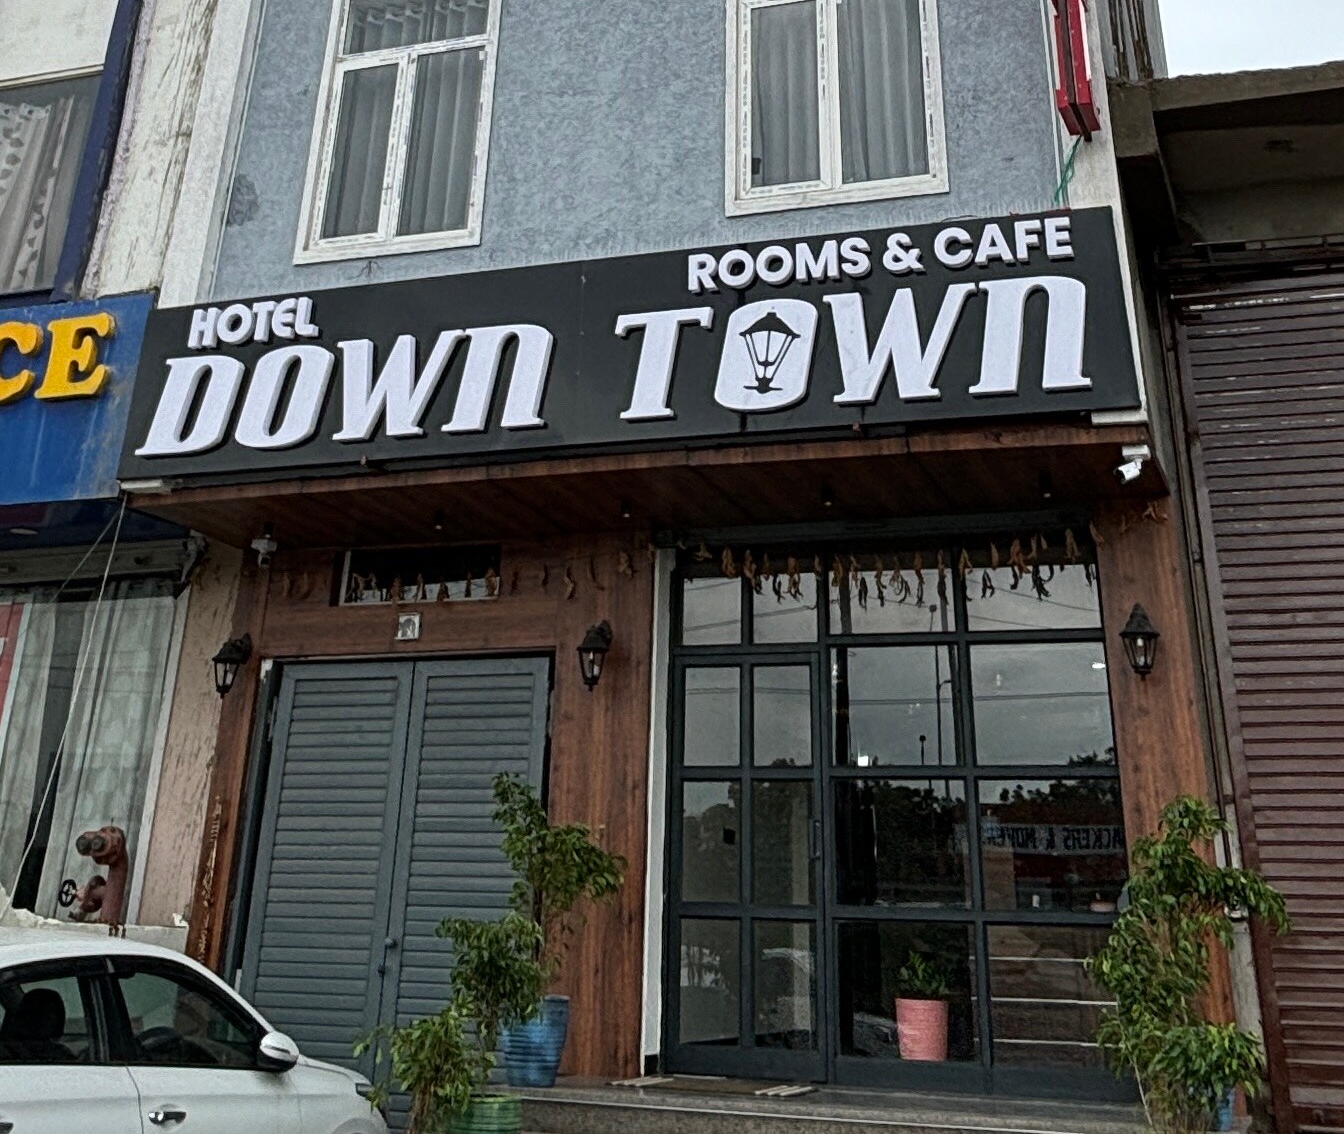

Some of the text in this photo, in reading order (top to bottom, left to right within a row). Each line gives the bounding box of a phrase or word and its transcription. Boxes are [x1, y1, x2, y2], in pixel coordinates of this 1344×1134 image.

[687, 217, 1074, 293] ROOMS & CAFE
[187, 297, 319, 349] HOTEL
